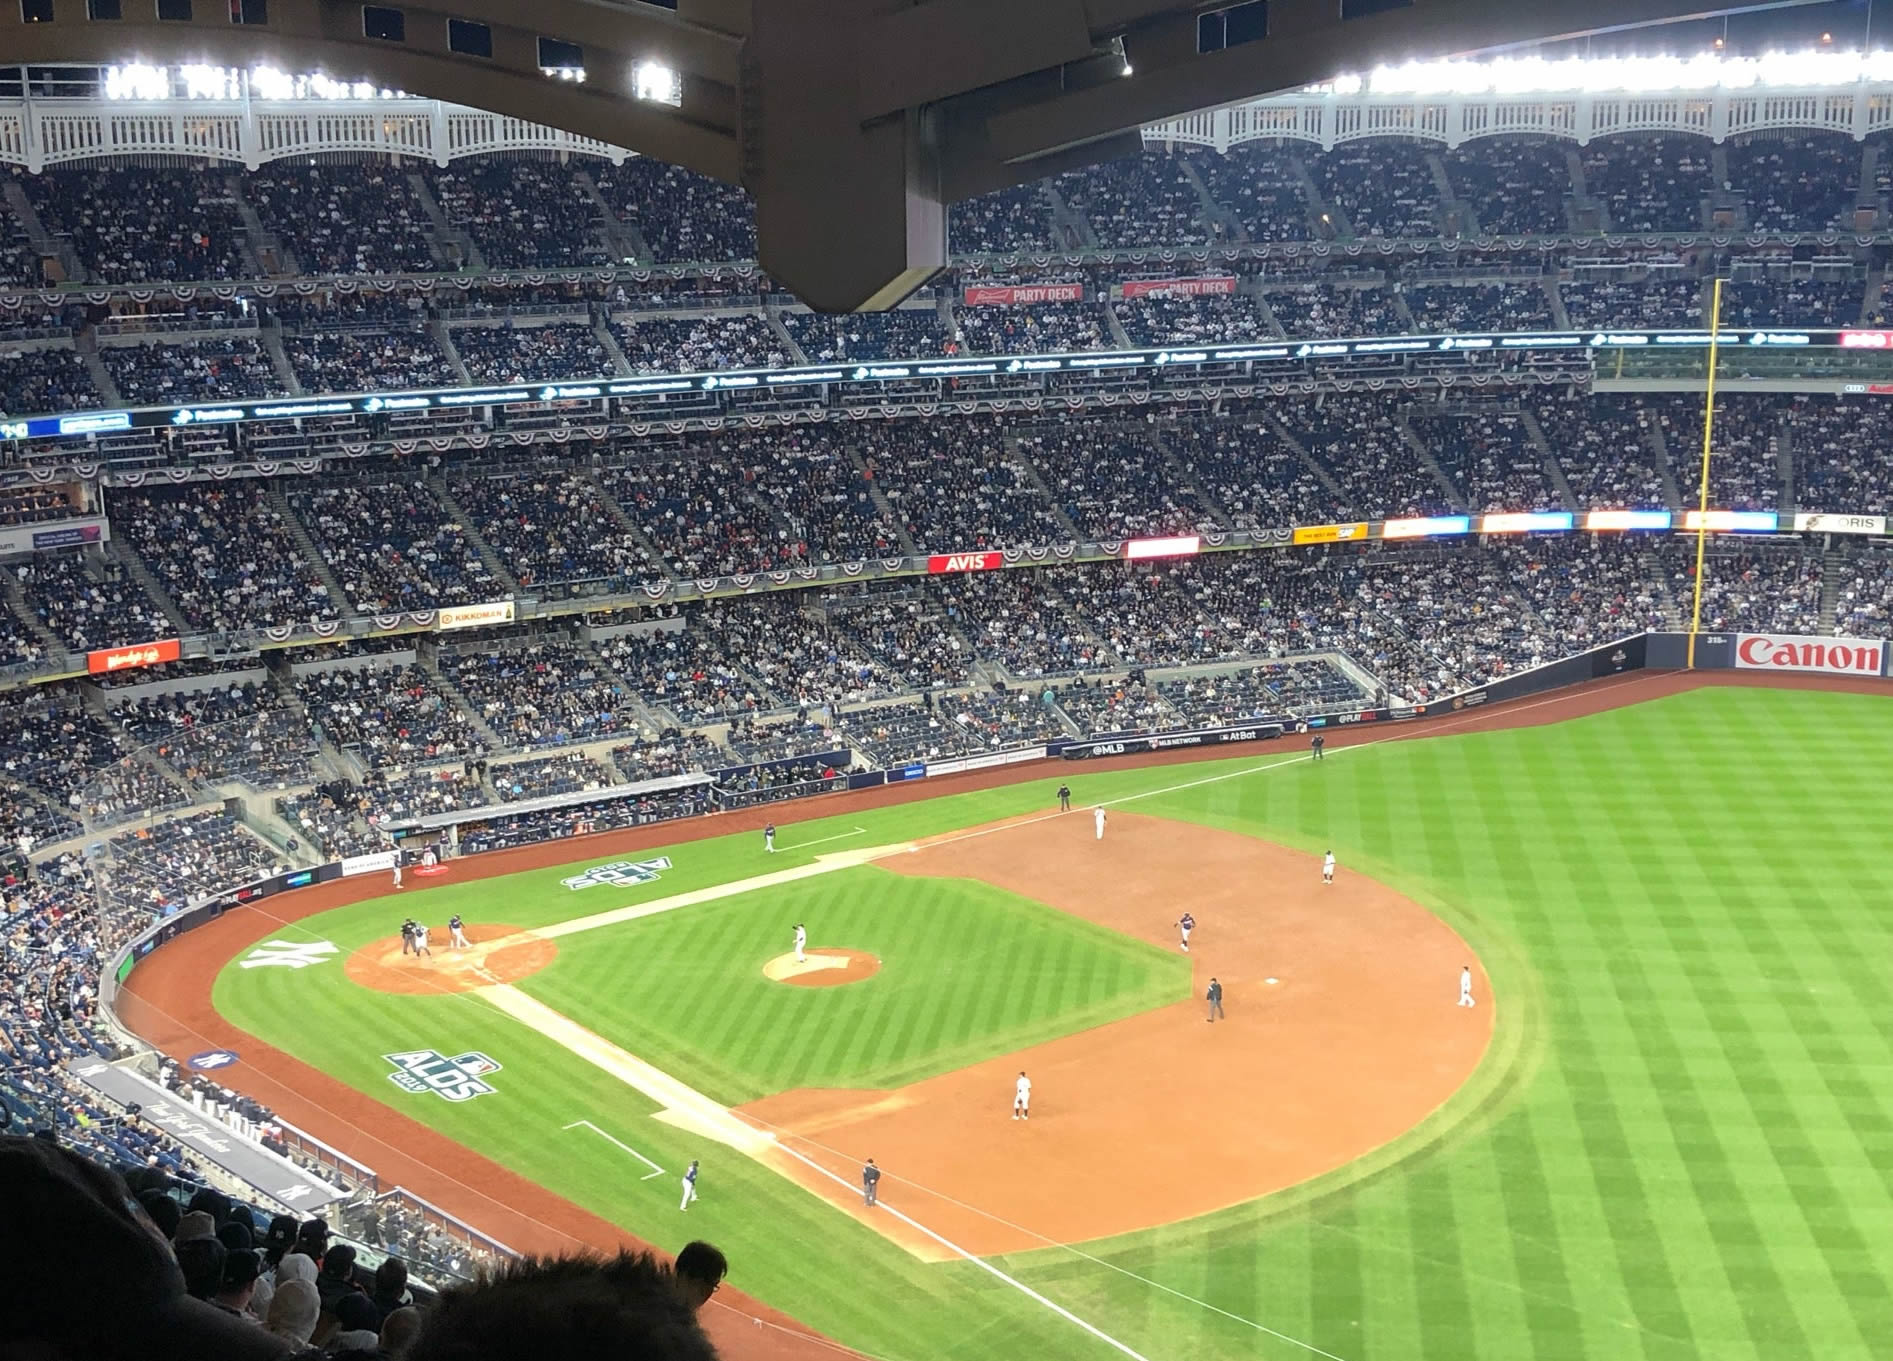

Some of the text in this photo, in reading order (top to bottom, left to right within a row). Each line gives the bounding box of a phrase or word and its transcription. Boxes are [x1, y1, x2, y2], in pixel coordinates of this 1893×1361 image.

[1013, 288, 1046, 302] PARTY
[1047, 287, 1076, 301] DECK
[1202, 281, 1229, 294] DECK
[1839, 517, 1874, 529] ORIS
[946, 555, 985, 571] AVIS
[455, 610, 502, 622] KIKKOMAN
[1739, 637, 1879, 671] Canon
[1171, 736, 1202, 745] NETWORK
[1092, 743, 1125, 755] @MLB
[388, 1050, 491, 1100] ALDS
[392, 1072, 428, 1091] 2019
